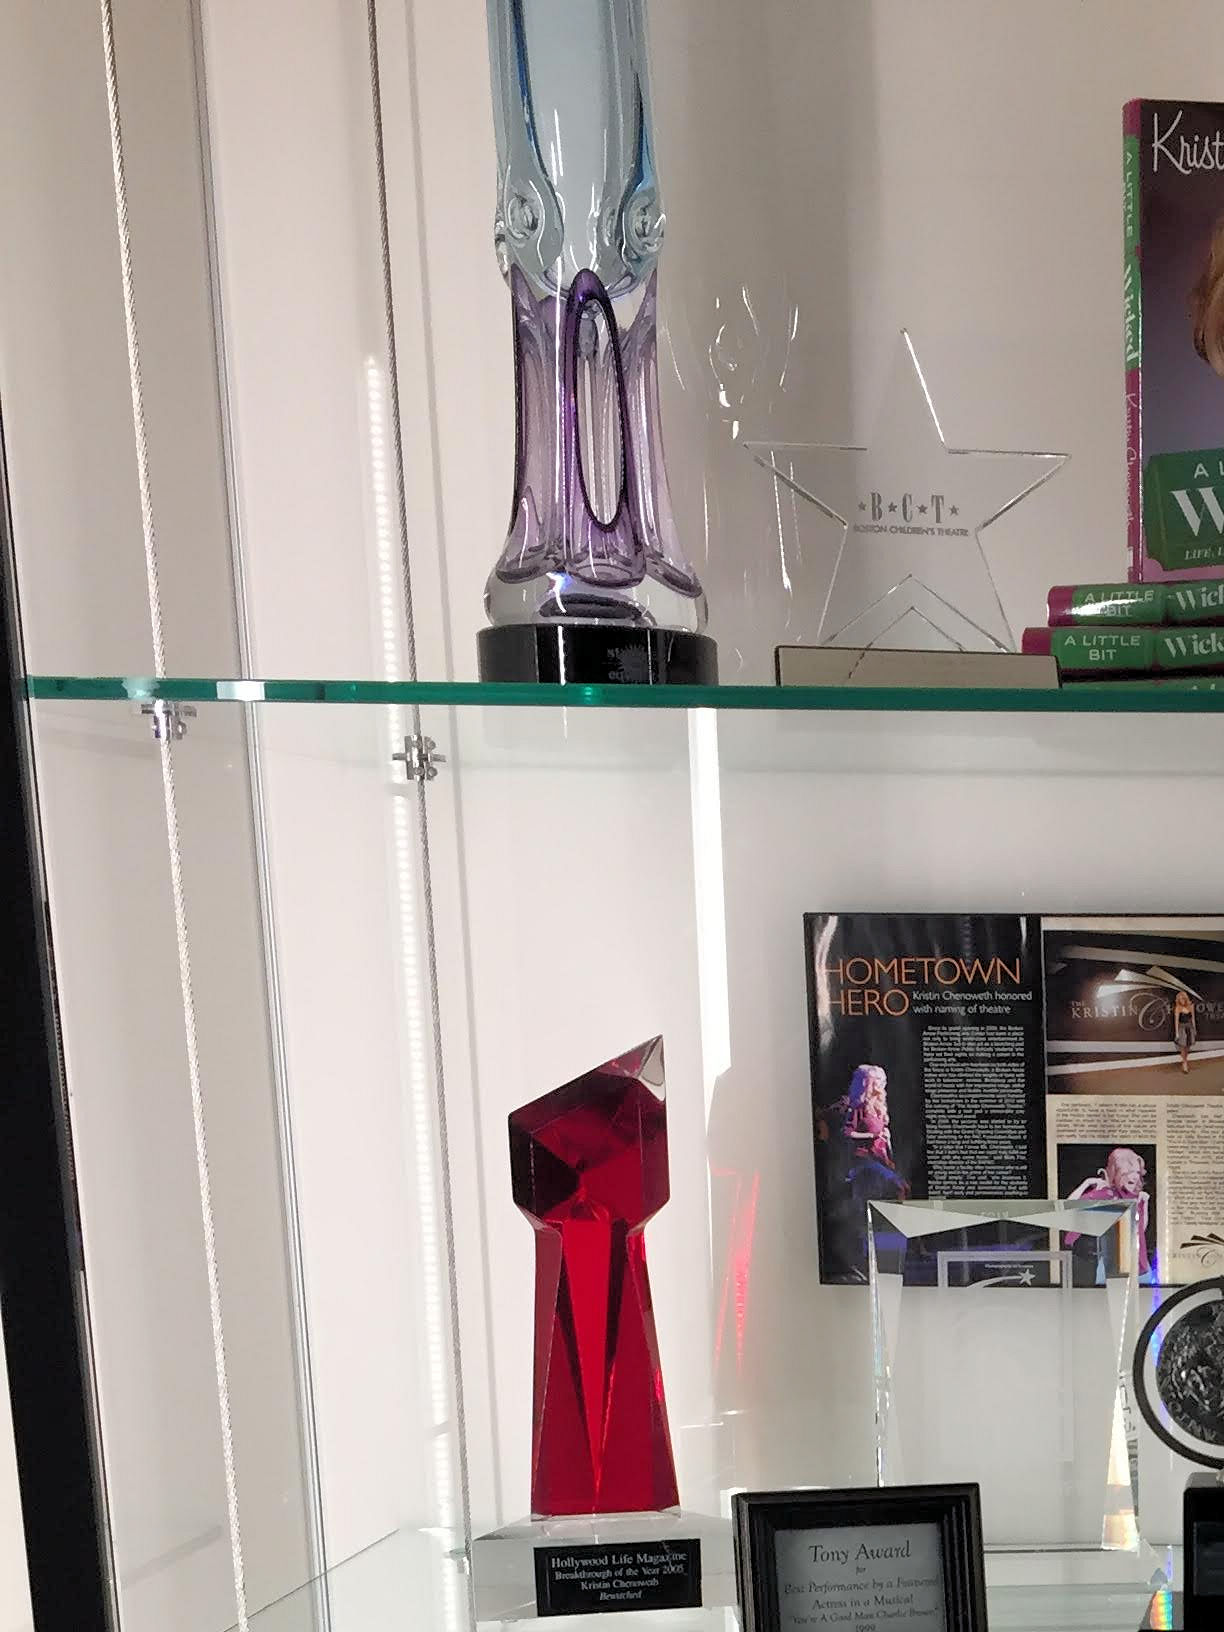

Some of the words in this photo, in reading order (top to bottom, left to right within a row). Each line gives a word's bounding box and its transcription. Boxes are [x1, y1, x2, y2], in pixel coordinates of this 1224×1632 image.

[1193, 463, 1208, 479] A
[1184, 546, 1214, 561] LIFE,
[1064, 635, 1076, 646] A
[1082, 635, 1141, 646] LITTLE
[1089, 649, 1117, 661] BIT
[822, 957, 1021, 985] HOMETOWN
[825, 989, 910, 1017] HERO
[912, 990, 940, 1001] Kristin
[941, 991, 993, 1001] Chenoweth
[994, 990, 1033, 1001] honored
[912, 1004, 932, 1014] with
[967, 1003, 977, 1014] of
[978, 1004, 1012, 1014] theatre
[808, 1544, 849, 1565] Tony
[854, 1540, 912, 1562] Award
[550, 1555, 609, 1573] Hollywood
[612, 1554, 634, 1566] Life
[636, 1551, 689, 1567] Magazine
[554, 1569, 612, 1582] Breakthrough
[614, 1567, 624, 1578] of
[625, 1566, 639, 1577] the
[641, 1565, 660, 1576] Year
[581, 1580, 611, 1592] Kristin
[612, 1577, 660, 1590] Chenoweth
[808, 1579, 868, 1595] Performance
[872, 1577, 884, 1592] by
[873, 1593, 914, 1607] Musical
